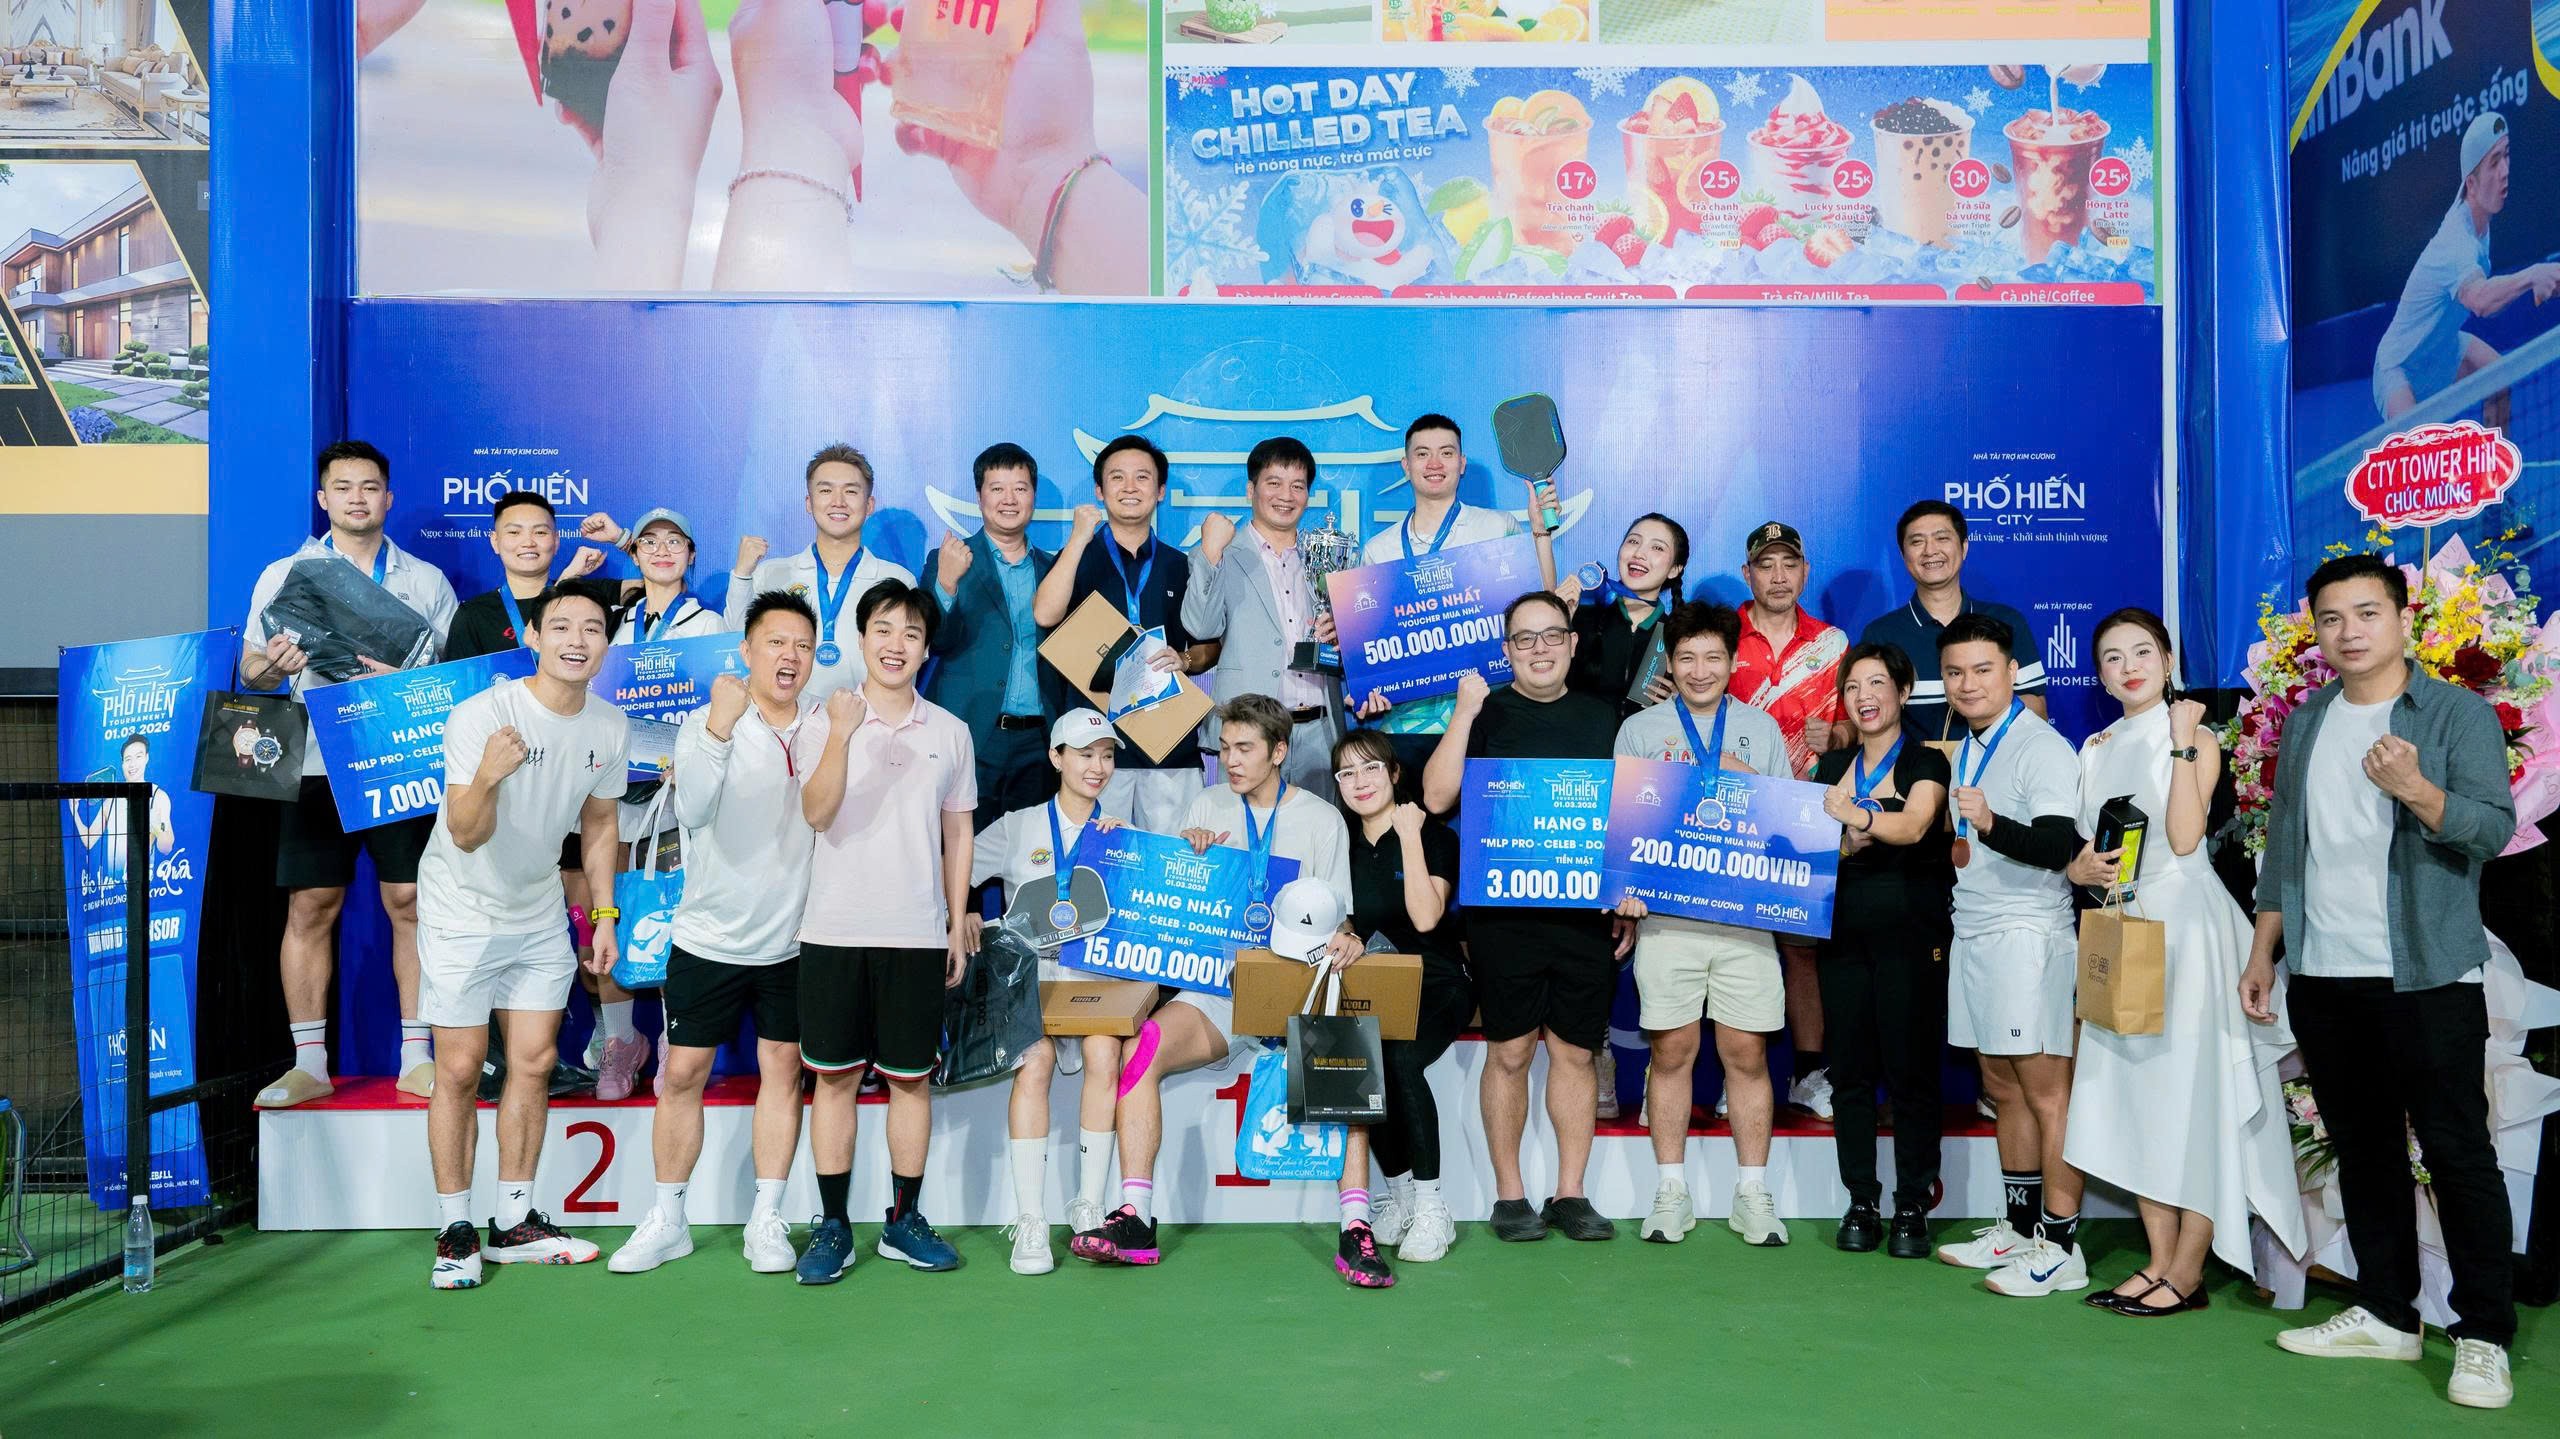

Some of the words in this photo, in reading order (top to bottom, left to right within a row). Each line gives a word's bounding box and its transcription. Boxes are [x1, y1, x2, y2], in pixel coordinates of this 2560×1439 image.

[1231, 82, 1319, 118] HOT
[1328, 72, 1415, 108] DAY
[1192, 114, 1370, 158] CHILLED
[1378, 104, 1468, 139] TEA
[2341, 148, 2377, 183] Nâng
[2382, 121, 2406, 172] giá
[2410, 114, 2427, 153] trị
[2430, 94, 2475, 139] cuộc
[2480, 64, 2528, 115] sống
[1235, 159, 1255, 175] Hè
[1258, 155, 1300, 173] nóng
[1303, 153, 1337, 171] nực,
[1340, 148, 1363, 164] trà
[1367, 145, 1400, 162] mát
[1403, 144, 1432, 161] cực
[1561, 171, 1594, 189] 17K
[1703, 170, 1738, 189] 25K
[1837, 170, 1871, 189] 25K
[1953, 170, 1987, 188] 30K
[2094, 169, 2129, 187] 25K
[1548, 203, 1562, 212] Trà
[1564, 203, 1594, 212] chanh
[1692, 202, 1707, 211] Trà
[1709, 202, 1739, 211] chanh
[1804, 202, 1833, 213] Lucky
[1836, 203, 1871, 211] sundae
[1957, 202, 1971, 210] Trà
[2103, 211, 2129, 219] Latte
[1719, 240, 1739, 248] NEW
[2108, 238, 2128, 246] NEW
[2001, 289, 2018, 302] Cà
[2022, 289, 2095, 303] phê/Coffee
[503, 448, 518, 456] TRỢ
[2002, 453, 2016, 461] TRỢ
[2367, 459, 2397, 489] CTY
[2400, 448, 2462, 484] TOWER
[2467, 441, 2497, 475] Hill
[444, 469, 512, 505] PHỐ
[1945, 474, 2011, 509] PHỐ
[2016, 474, 2085, 509] HIẾN
[2385, 486, 2421, 514] CHÚC
[2425, 480, 2472, 508] MỪNG
[1997, 515, 2033, 525] CITY
[420, 529, 443, 539] Ngọc
[444, 528, 465, 538] sáng
[467, 526, 482, 538] đất
[558, 530, 582, 539] thịnh
[1968, 530, 1982, 542] đất
[1984, 533, 2004, 544] vàng
[2013, 532, 2033, 542] Khởi
[2035, 532, 2054, 542] sinh
[2056, 532, 2079, 543] thịnh
[2081, 533, 2108, 544] vượng
[1418, 583, 1454, 595] 01.03.2026
[1394, 597, 1438, 619] HẠNG
[1442, 586, 1481, 608] NHẤT
[2063, 603, 2076, 611] TRỢ
[2077, 603, 2092, 611] BẠC
[1443, 609, 1461, 621] MUA
[1363, 614, 1506, 666] 500.000.000V
[637, 672, 674, 681] 01.03.2026
[1383, 682, 1400, 694] NHÀ
[1402, 679, 1414, 689] TÀI
[1415, 676, 1431, 687] TRỢ
[1432, 673, 1447, 683] KIM
[1448, 667, 1478, 680] CƯƠNG
[2045, 677, 2098, 686] THOMES
[616, 684, 662, 702] HẠNG
[667, 679, 694, 695] NHÌ
[656, 700, 675, 708] MUA
[109, 713, 166, 726] TOURNAMENT
[104, 721, 170, 740] 01.03.2026
[392, 721, 445, 745] HẠNG
[380, 753, 404, 766] PRO
[1554, 801, 1597, 809] 01.03.2026
[1533, 816, 1586, 833] HẠNG
[1737, 820, 1758, 836] BA
[1512, 838, 1535, 848] PRO
[1544, 839, 1576, 849] CELEB
[1724, 836, 1745, 847] MUA
[1555, 853, 1574, 864] TIỀN
[1576, 855, 1593, 866] MẶT
[1630, 836, 1811, 888] 200.000.000VNĐ
[1165, 879, 1207, 893] 01.03.2026
[1487, 868, 1602, 900] 3.000.00
[1132, 888, 1181, 909] HẠNG
[1187, 898, 1232, 919] NHẤT
[1625, 886, 1636, 897] TỪ
[1637, 887, 1655, 899] NHÀ
[1658, 889, 1672, 901] TÀI
[1673, 892, 1692, 904] TRỢ
[1692, 895, 1708, 906] KIM
[1711, 898, 1744, 912] CƯƠNG
[1756, 901, 1781, 918] PHỐ
[1781, 904, 1808, 921] HIẾN
[1118, 909, 1140, 921] PRO
[1149, 914, 1180, 928] CELEB
[1188, 921, 1228, 938] DOANH
[1157, 931, 1174, 944] TIỀN
[1083, 936, 1231, 988] 15.000.000V
[564, 1121, 619, 1212] 2
